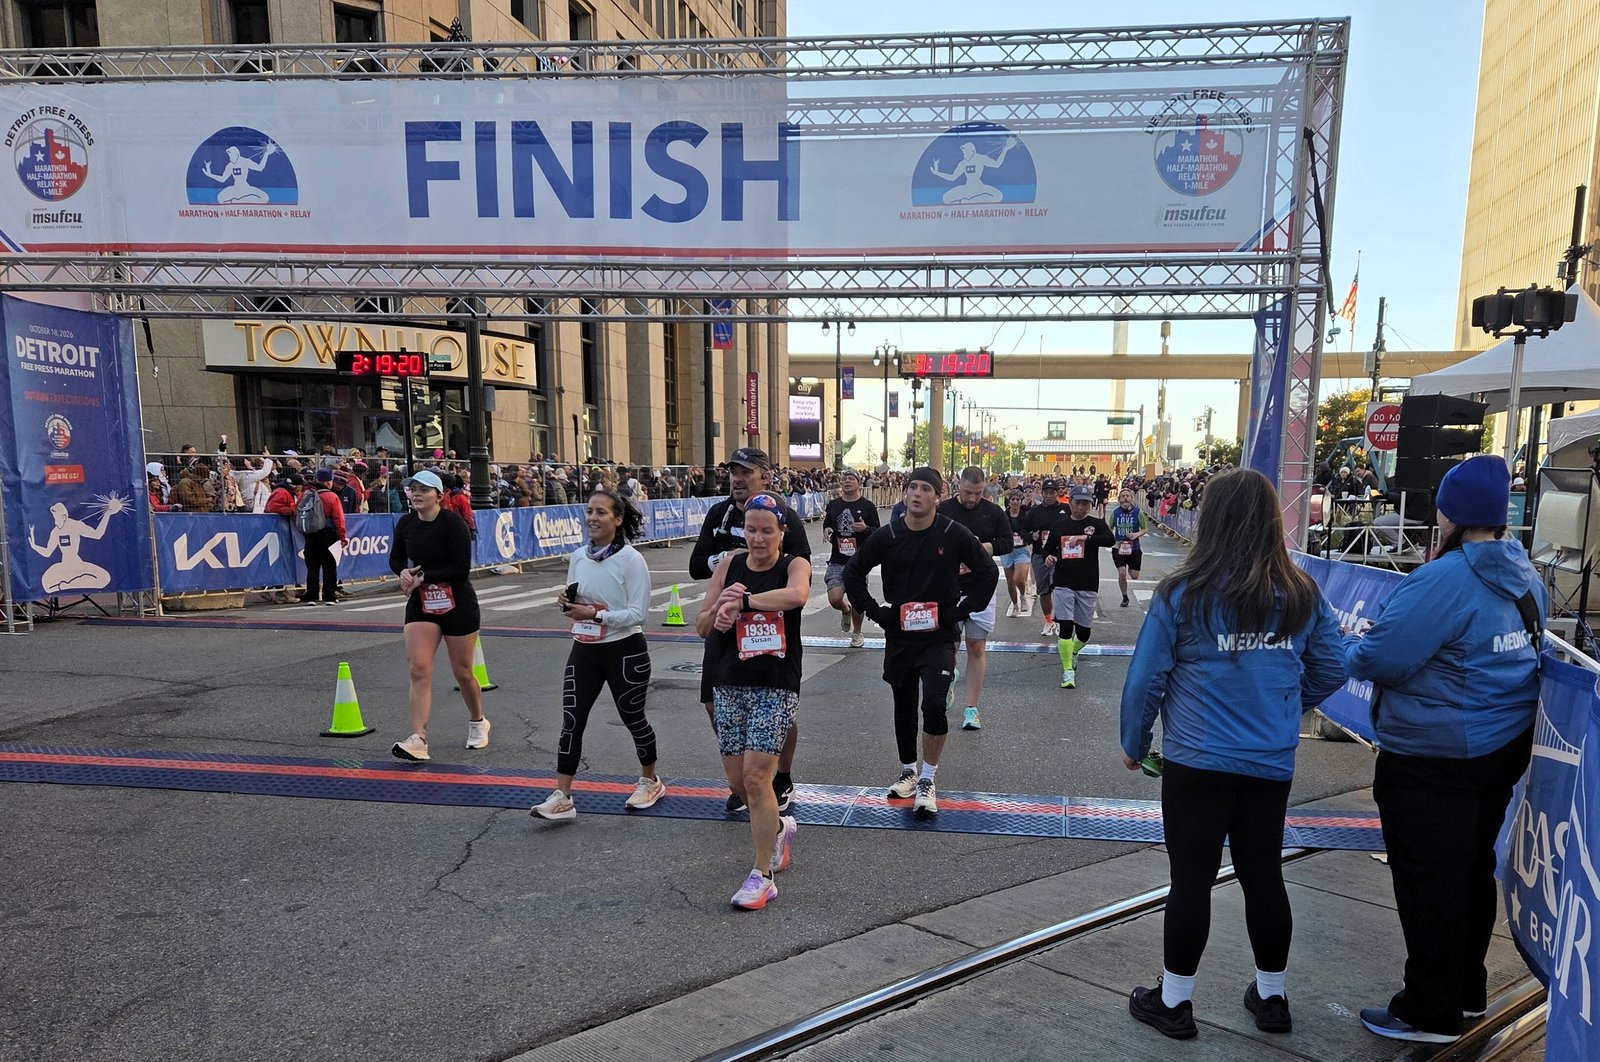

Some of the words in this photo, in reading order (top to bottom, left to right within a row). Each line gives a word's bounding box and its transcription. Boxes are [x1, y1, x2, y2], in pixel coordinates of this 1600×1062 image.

[1192, 88, 1226, 103] FREE
[4, 108, 36, 147] DETROIT
[39, 105, 66, 118] FREE
[67, 113, 95, 146] PRESS
[404, 120, 800, 223] FINISH
[1166, 164, 1228, 172] HALF-MARATHON
[26, 172, 77, 180] HALF-MARATHON
[32, 209, 83, 224] msufcu
[178, 209, 219, 218] MARATHON
[225, 209, 282, 218] HALF-MARATHON
[290, 210, 311, 218] RELAY
[900, 211, 942, 220] MARATHON
[950, 209, 1016, 219] HALF-MARATHON
[1024, 208, 1048, 217] RELAY
[1164, 205, 1227, 220] msufcu
[29, 325, 51, 334] OCTOBER
[59, 330, 74, 338] 2026
[15, 335, 100, 368] DETROIT
[20, 361, 34, 371] FREE
[34, 364, 54, 374] PRESS
[54, 367, 95, 378] MARATHON
[797, 382, 812, 394] ally
[747, 409, 758, 429] plum
[1373, 413, 1385, 421] DO
[1390, 413, 1401, 421] NO
[1116, 517, 1134, 527] LOVE
[342, 535, 390, 556] ROOKS
[905, 610, 932, 620] 22436
[743, 623, 777, 637] 19338
[1217, 631, 1294, 652] MEDICAL
[1493, 628, 1533, 653] MEDIC
[1530, 910, 1554, 957] BR
